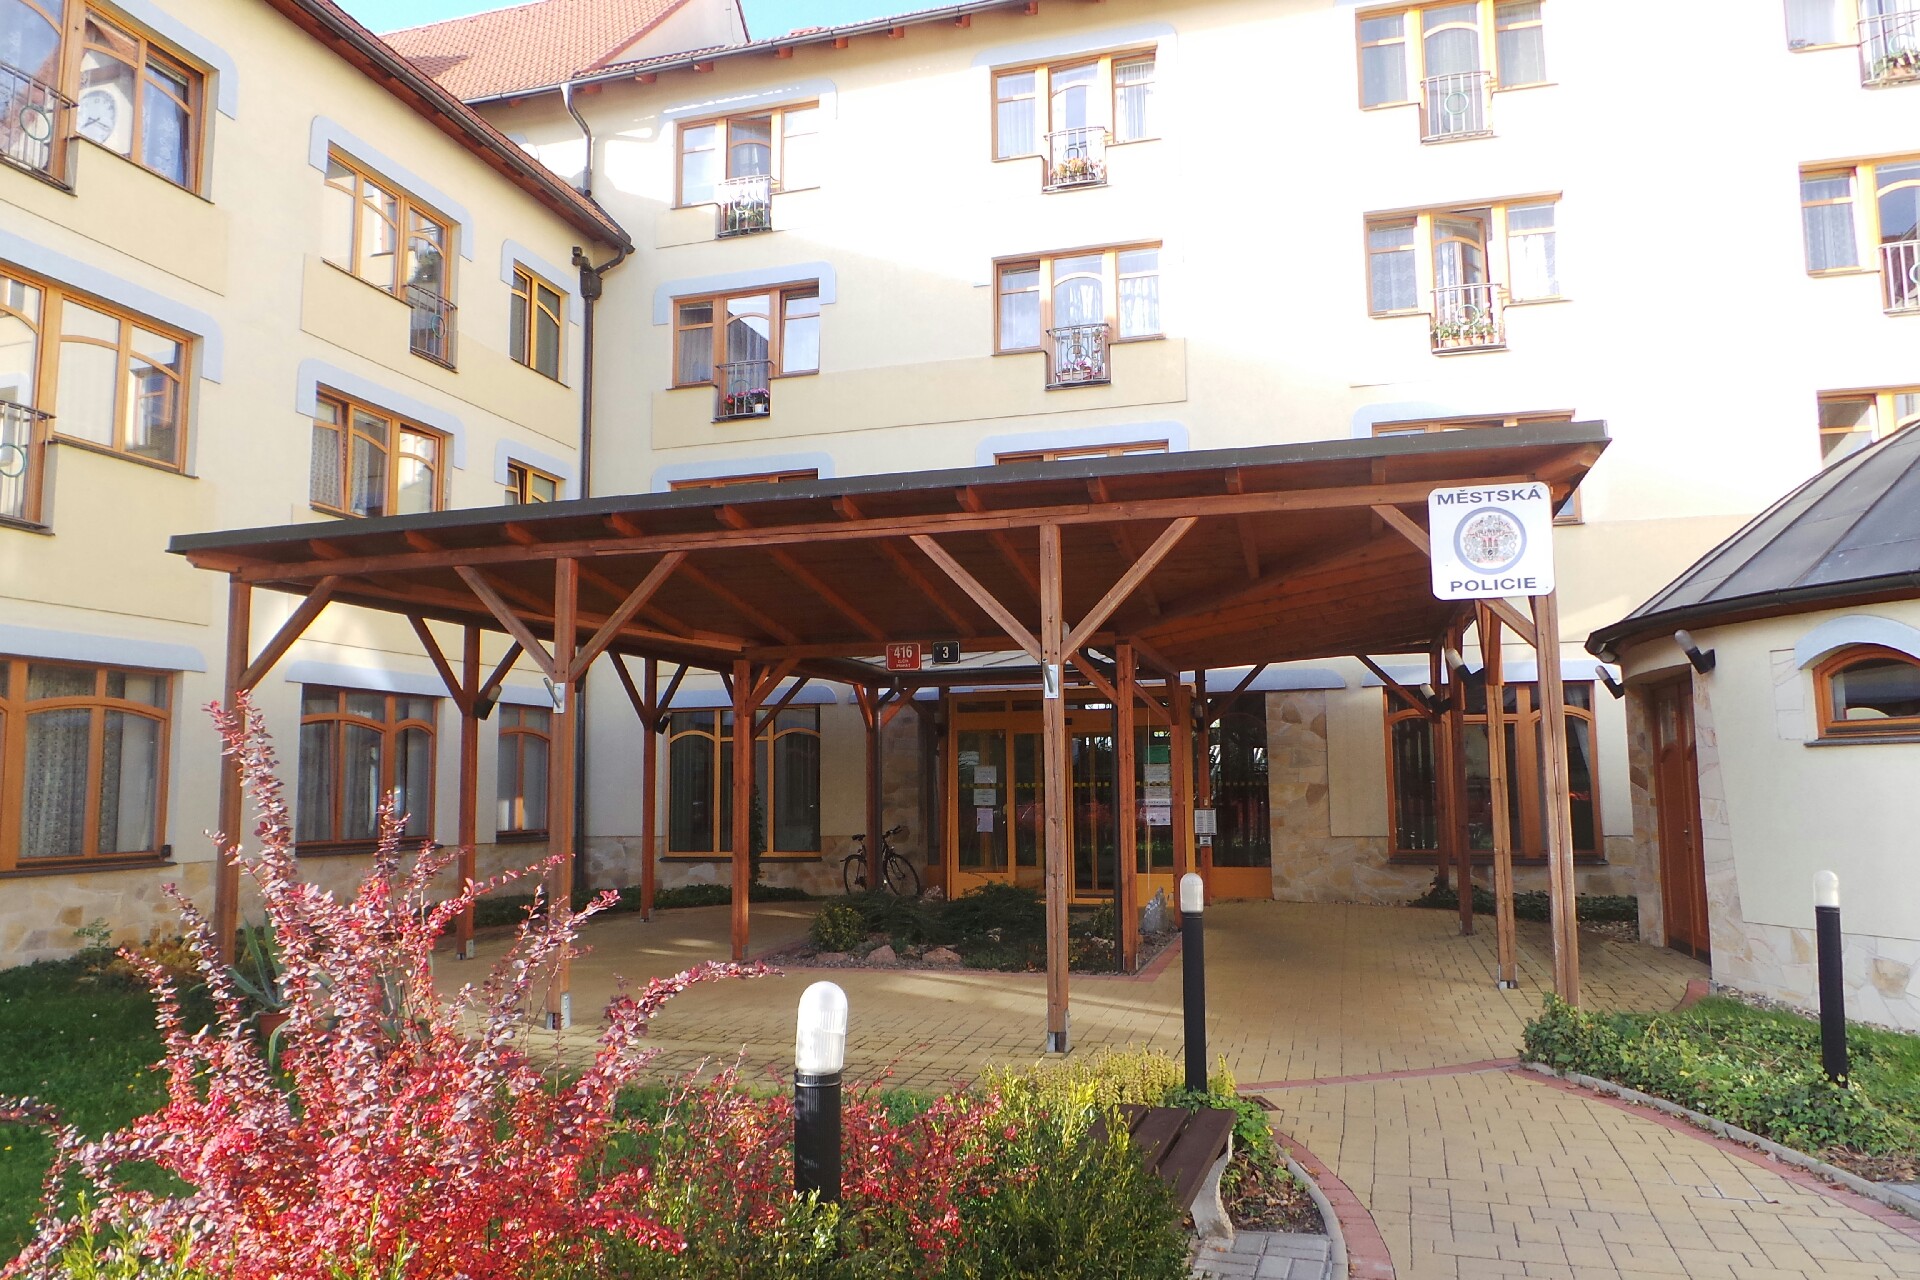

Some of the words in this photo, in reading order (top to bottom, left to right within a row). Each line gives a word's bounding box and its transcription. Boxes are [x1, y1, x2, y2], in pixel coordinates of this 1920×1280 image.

[1437, 485, 1542, 505] MĚSTSKÁ
[1450, 577, 1537, 592] POLICIE
[894, 645, 913, 658] 416
[942, 646, 949, 658] 3
